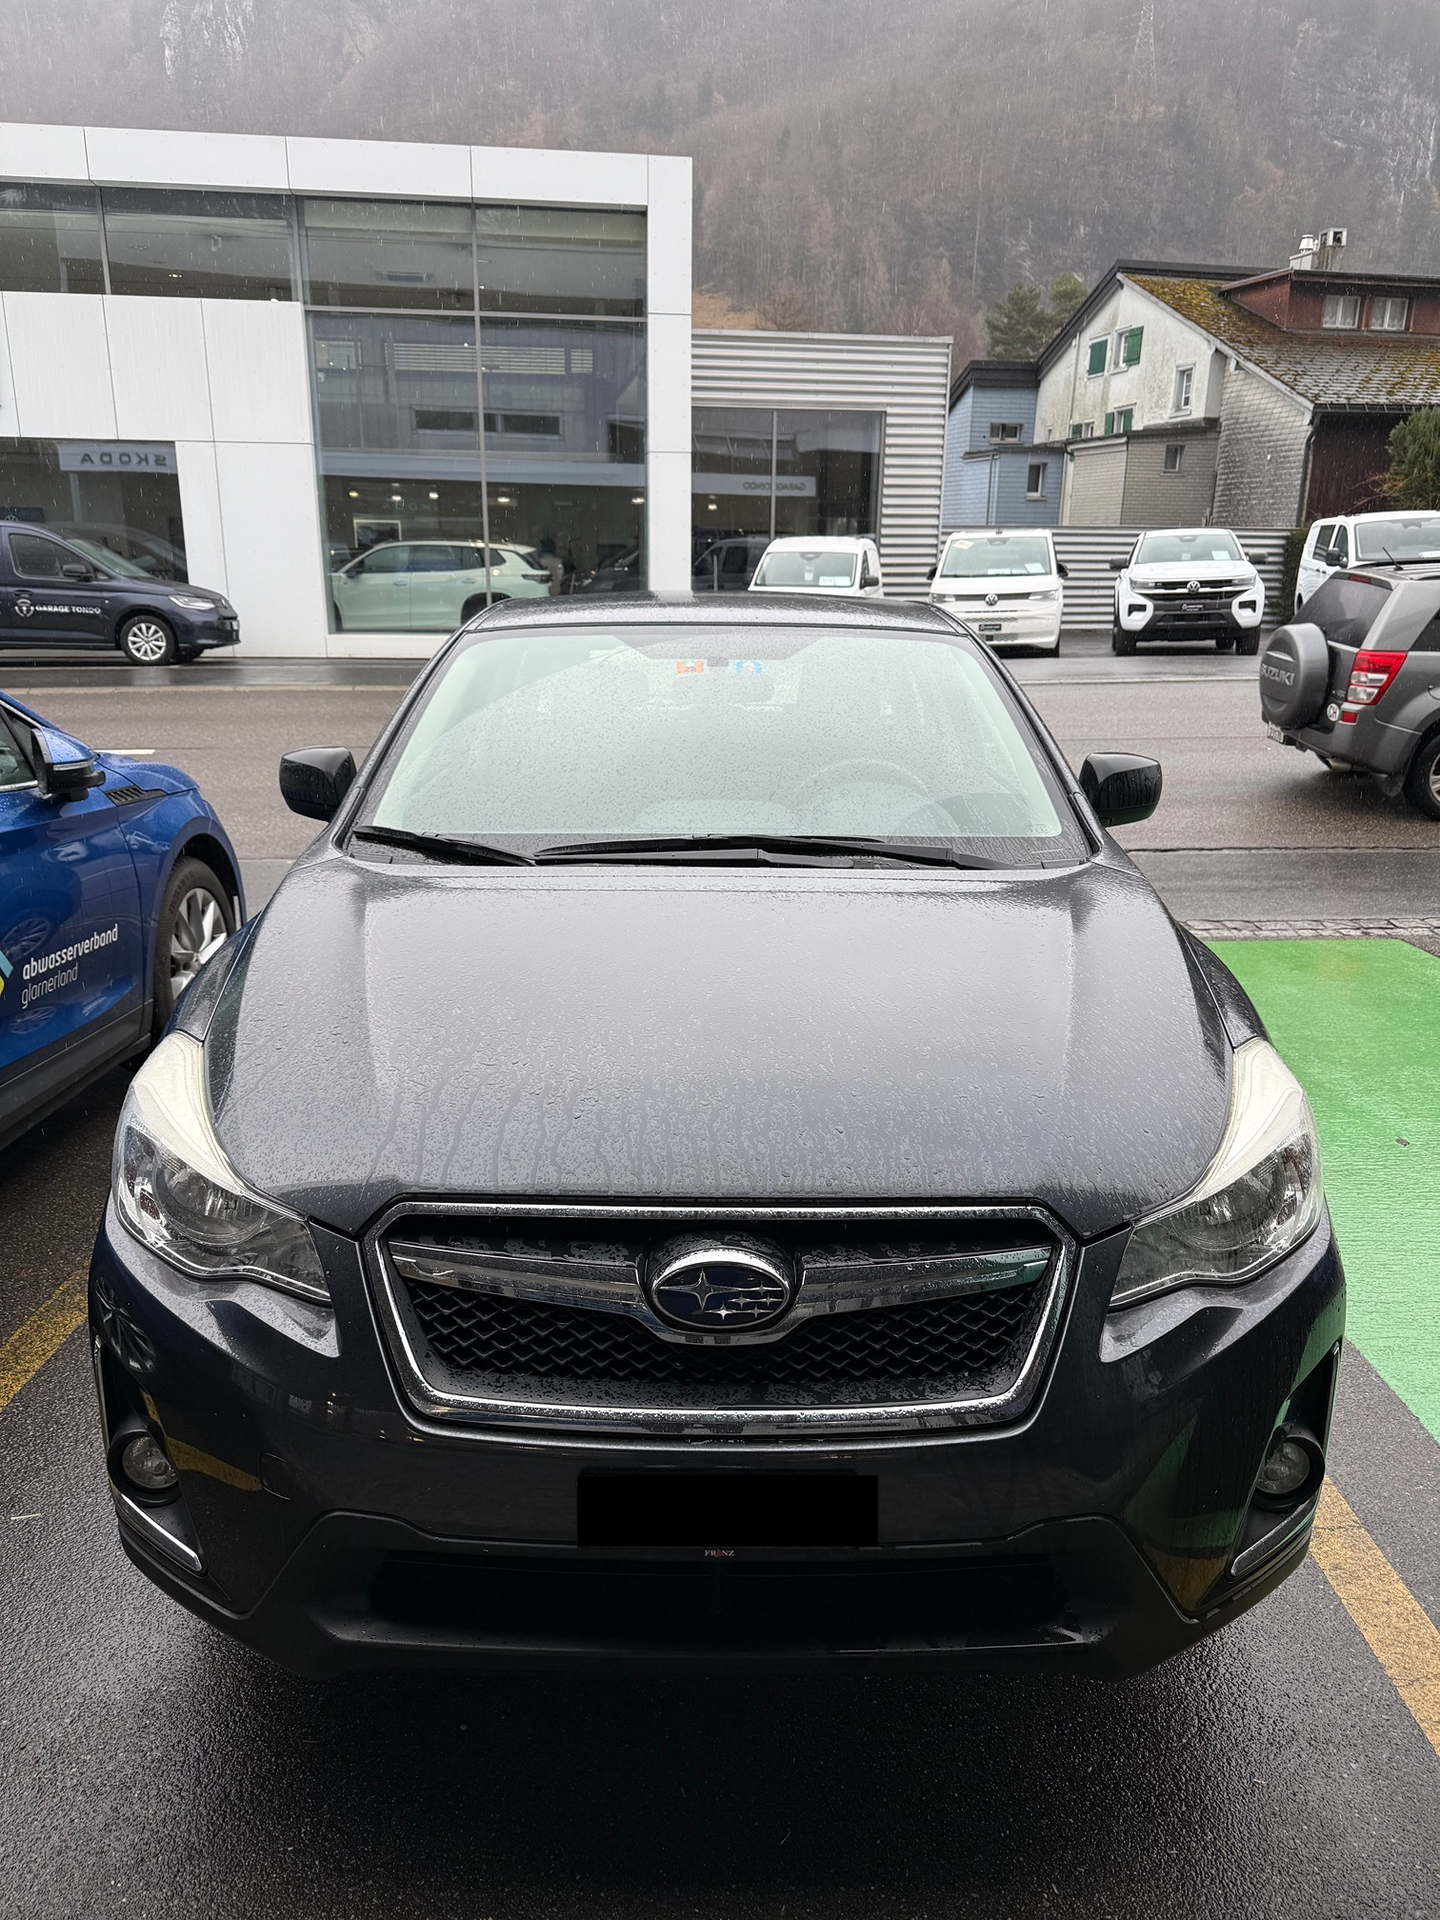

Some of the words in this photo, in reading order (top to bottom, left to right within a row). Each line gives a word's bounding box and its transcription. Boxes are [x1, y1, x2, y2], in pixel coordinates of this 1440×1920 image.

[35, 604, 70, 613] GARAGE
[71, 606, 102, 614] TONDO
[1260, 663, 1296, 686] SUZUKI
[1328, 704, 1338, 720] CH
[22, 923, 119, 980] abwasserverband
[21, 961, 79, 1010] glarnerland
